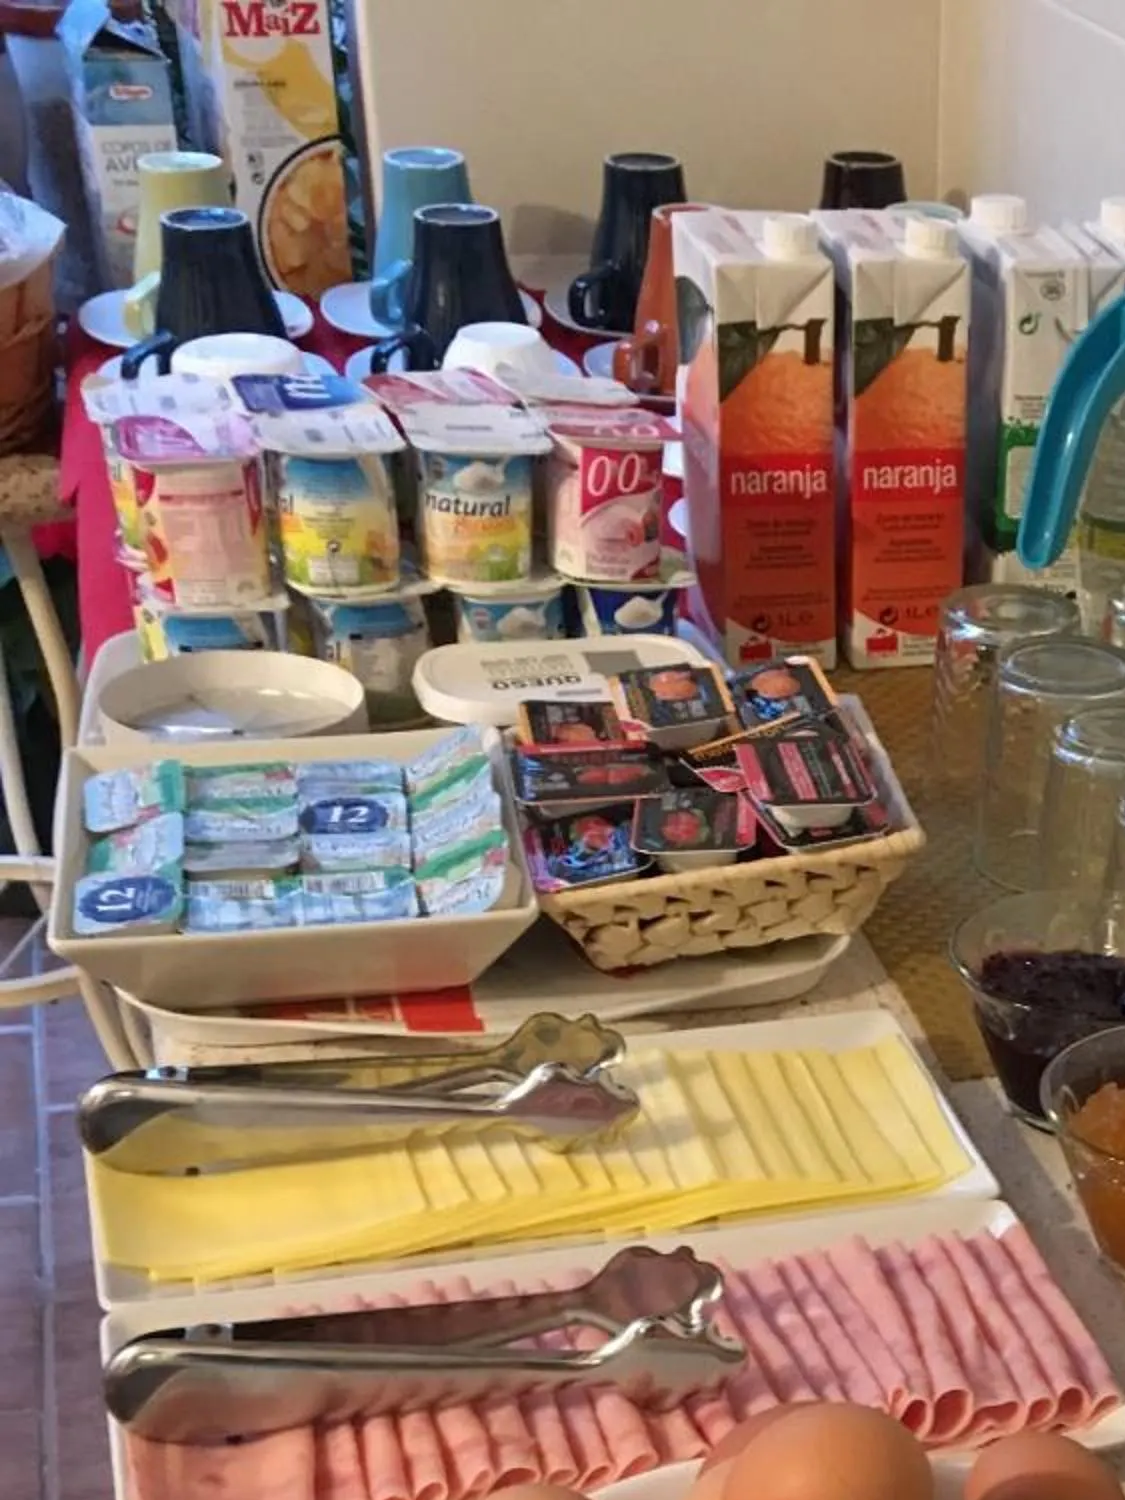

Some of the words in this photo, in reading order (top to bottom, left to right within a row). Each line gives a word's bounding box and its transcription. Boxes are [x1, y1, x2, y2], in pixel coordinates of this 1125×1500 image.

[730, 463, 828, 499] naranja
[863, 458, 957, 494] naranja
[424, 493, 511, 517] natural
[492, 675, 582, 691] QUESO
[326, 805, 370, 823] 12
[95, 887, 136, 912] 12
